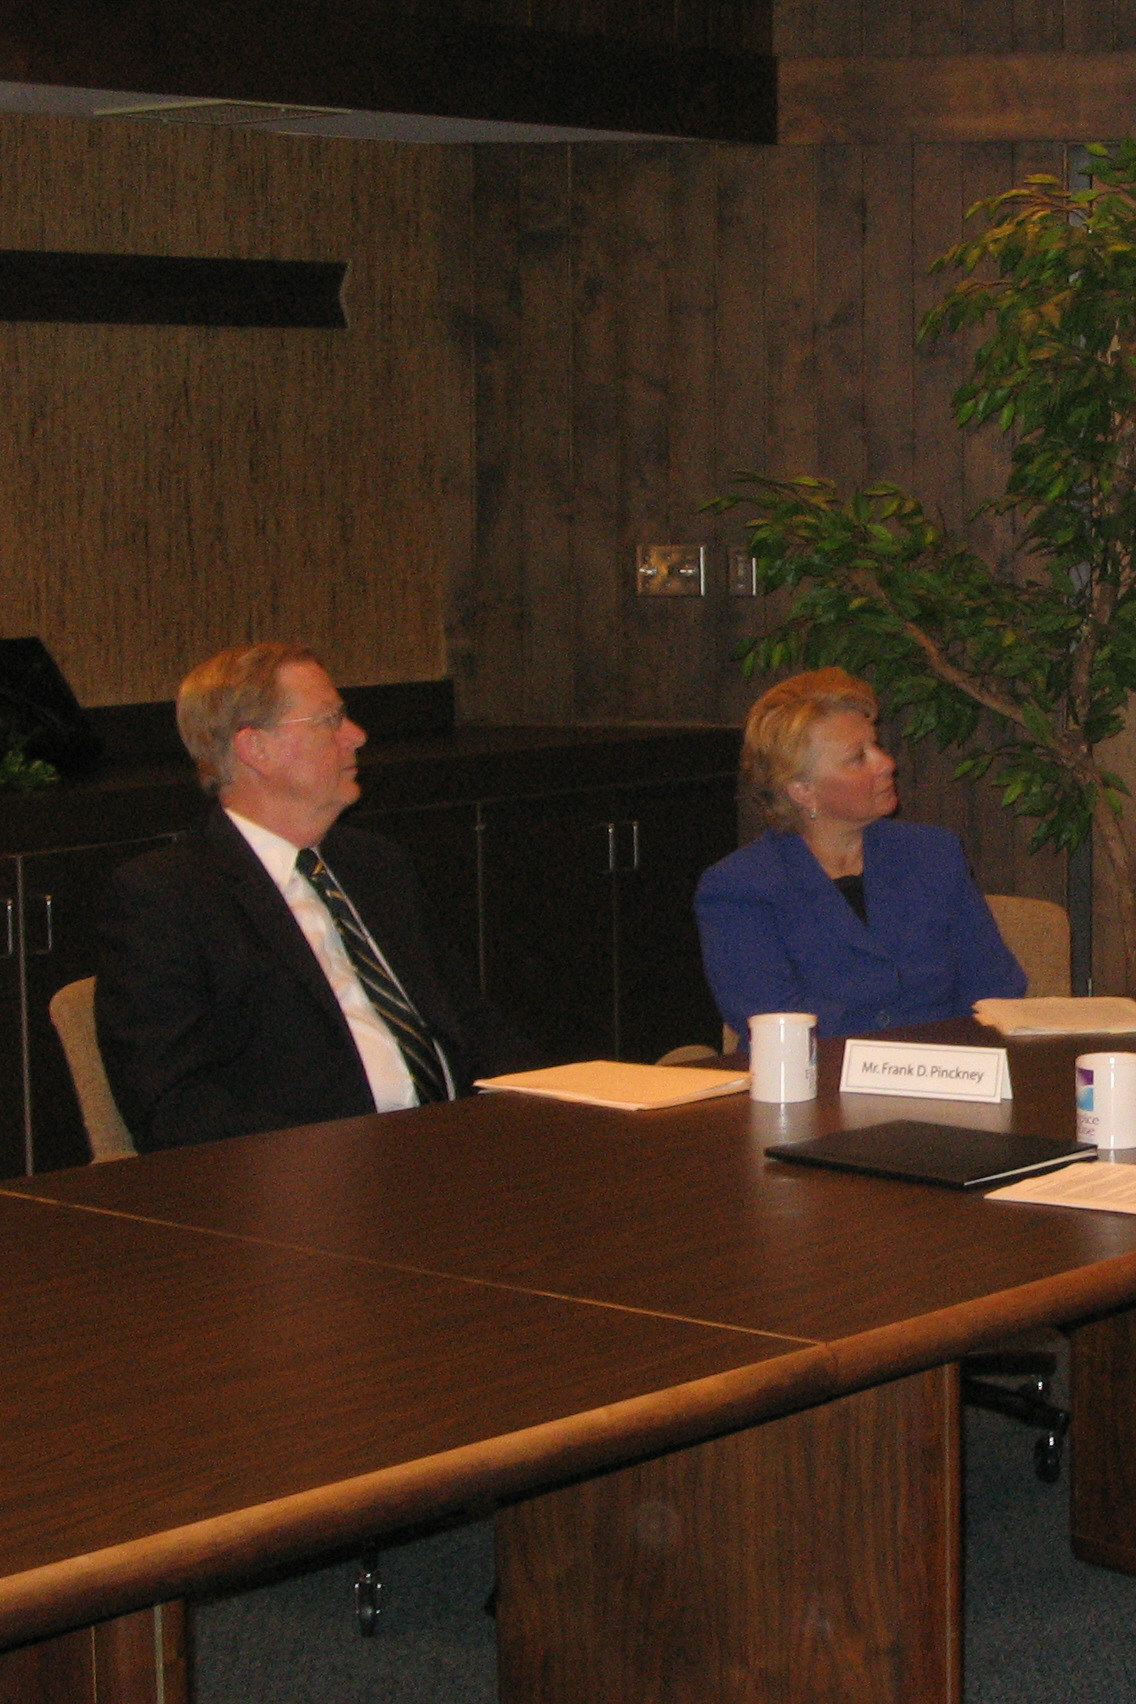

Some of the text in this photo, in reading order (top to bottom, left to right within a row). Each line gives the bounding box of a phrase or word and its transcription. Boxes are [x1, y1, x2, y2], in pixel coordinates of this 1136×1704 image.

[862, 1061, 984, 1083] Mr. Frank D. Pinckney
